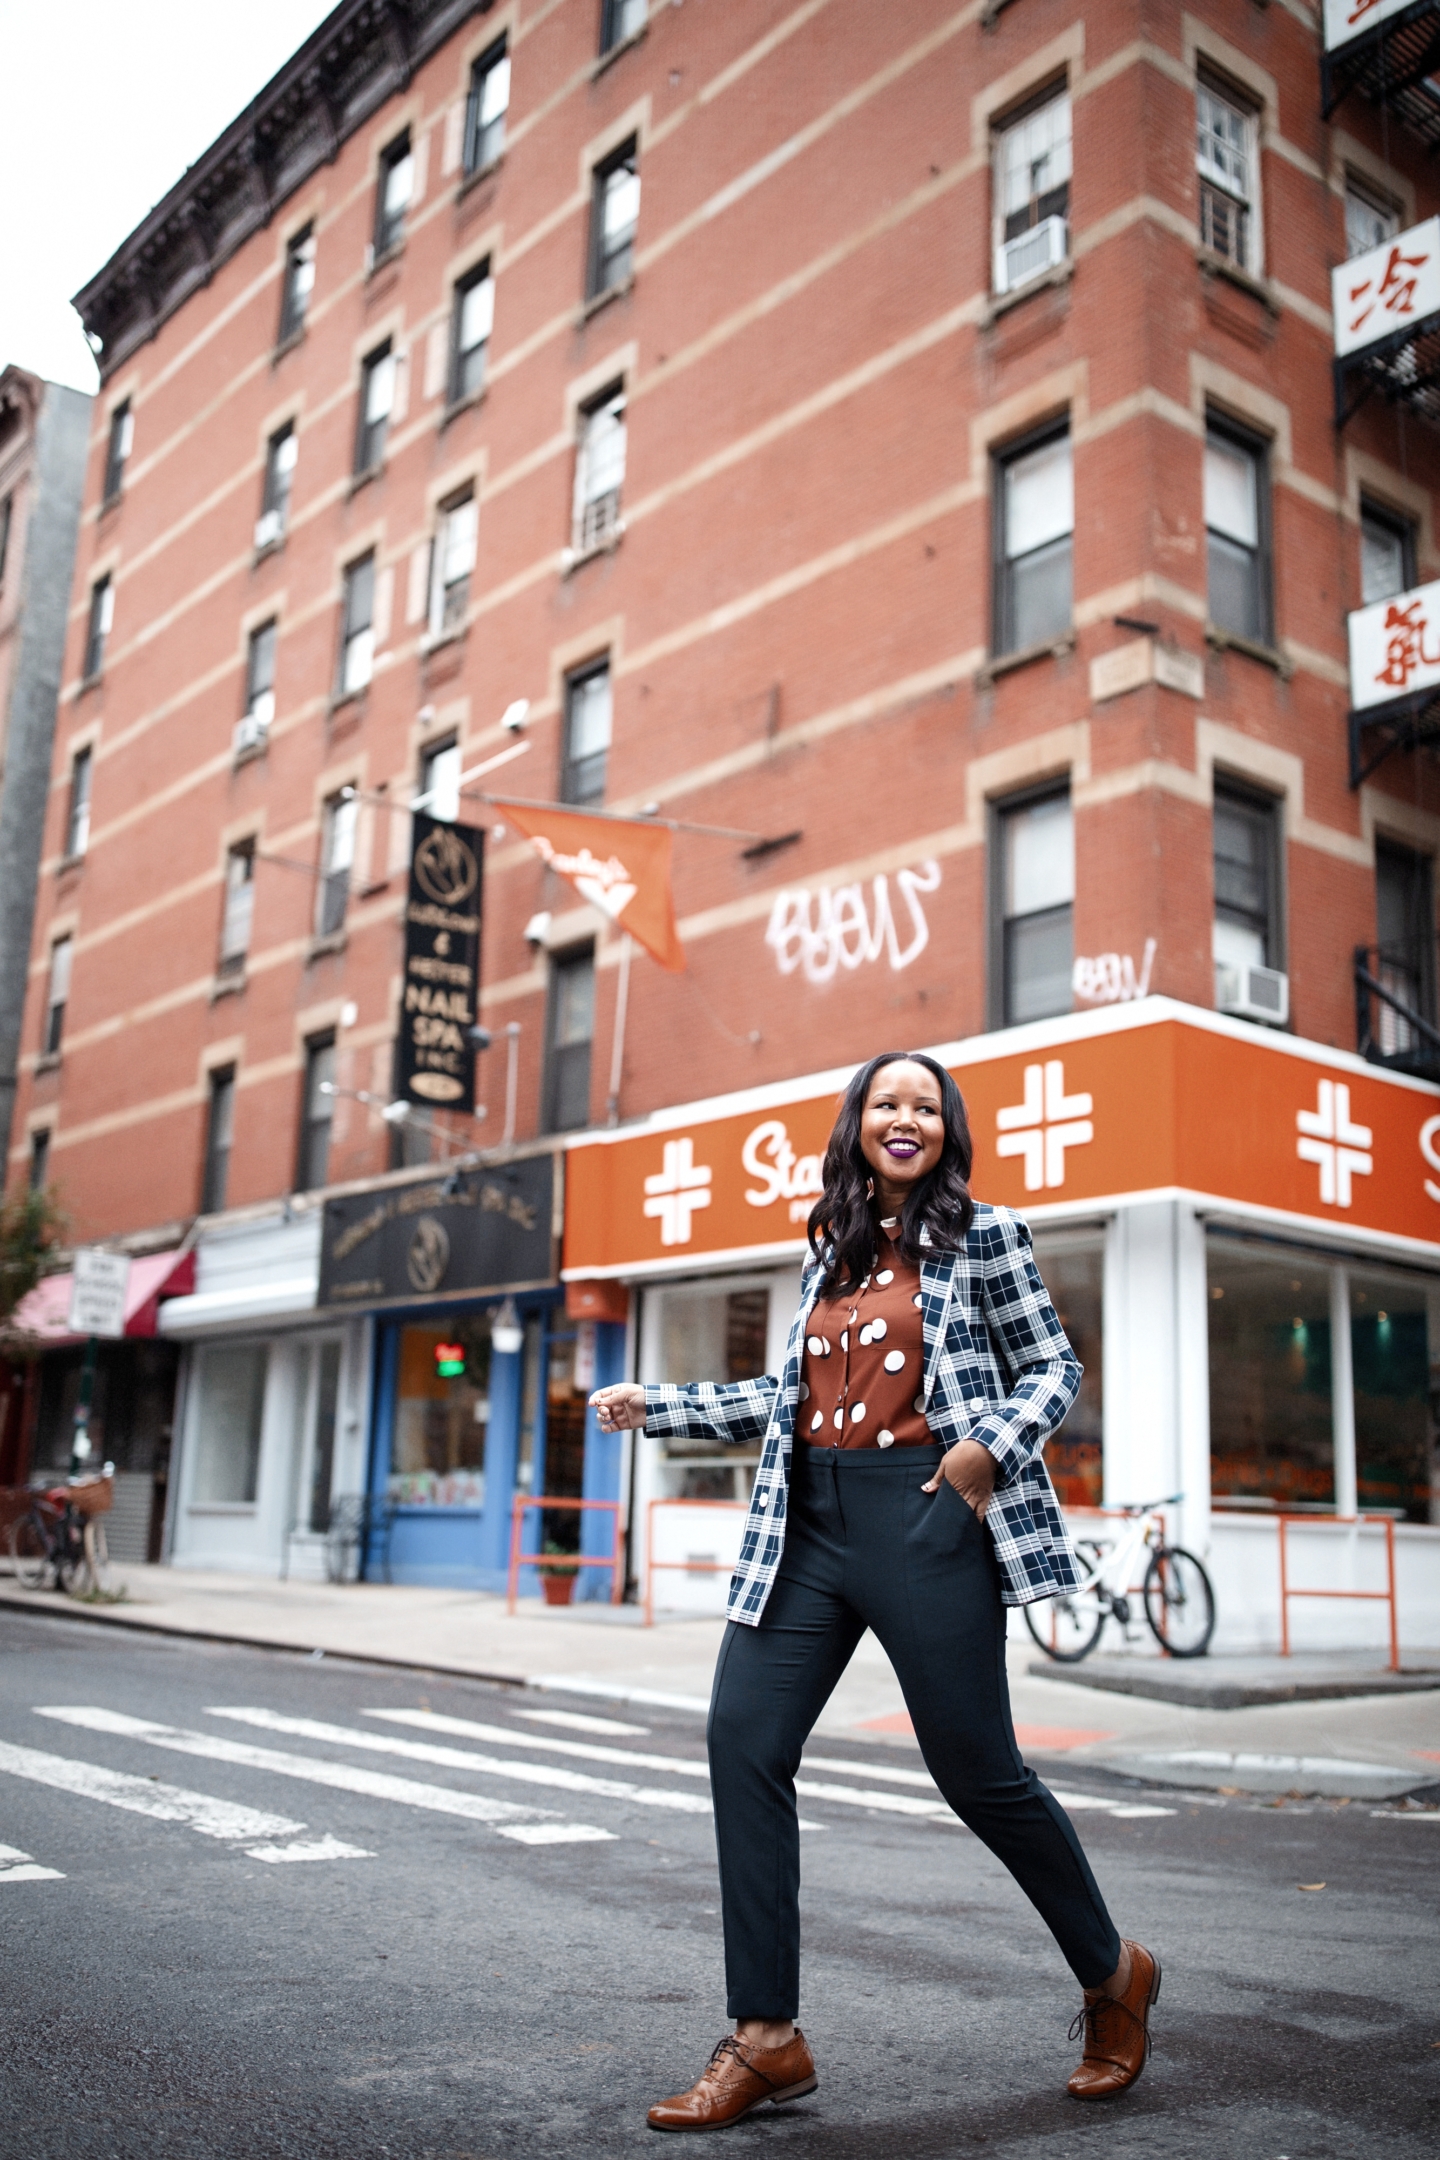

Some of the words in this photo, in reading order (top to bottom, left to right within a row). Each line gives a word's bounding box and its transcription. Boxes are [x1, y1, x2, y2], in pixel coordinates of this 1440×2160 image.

[405, 984, 474, 1023] NAIL
[412, 1016, 465, 1051] SPA
[742, 1121, 826, 1206] Sta
